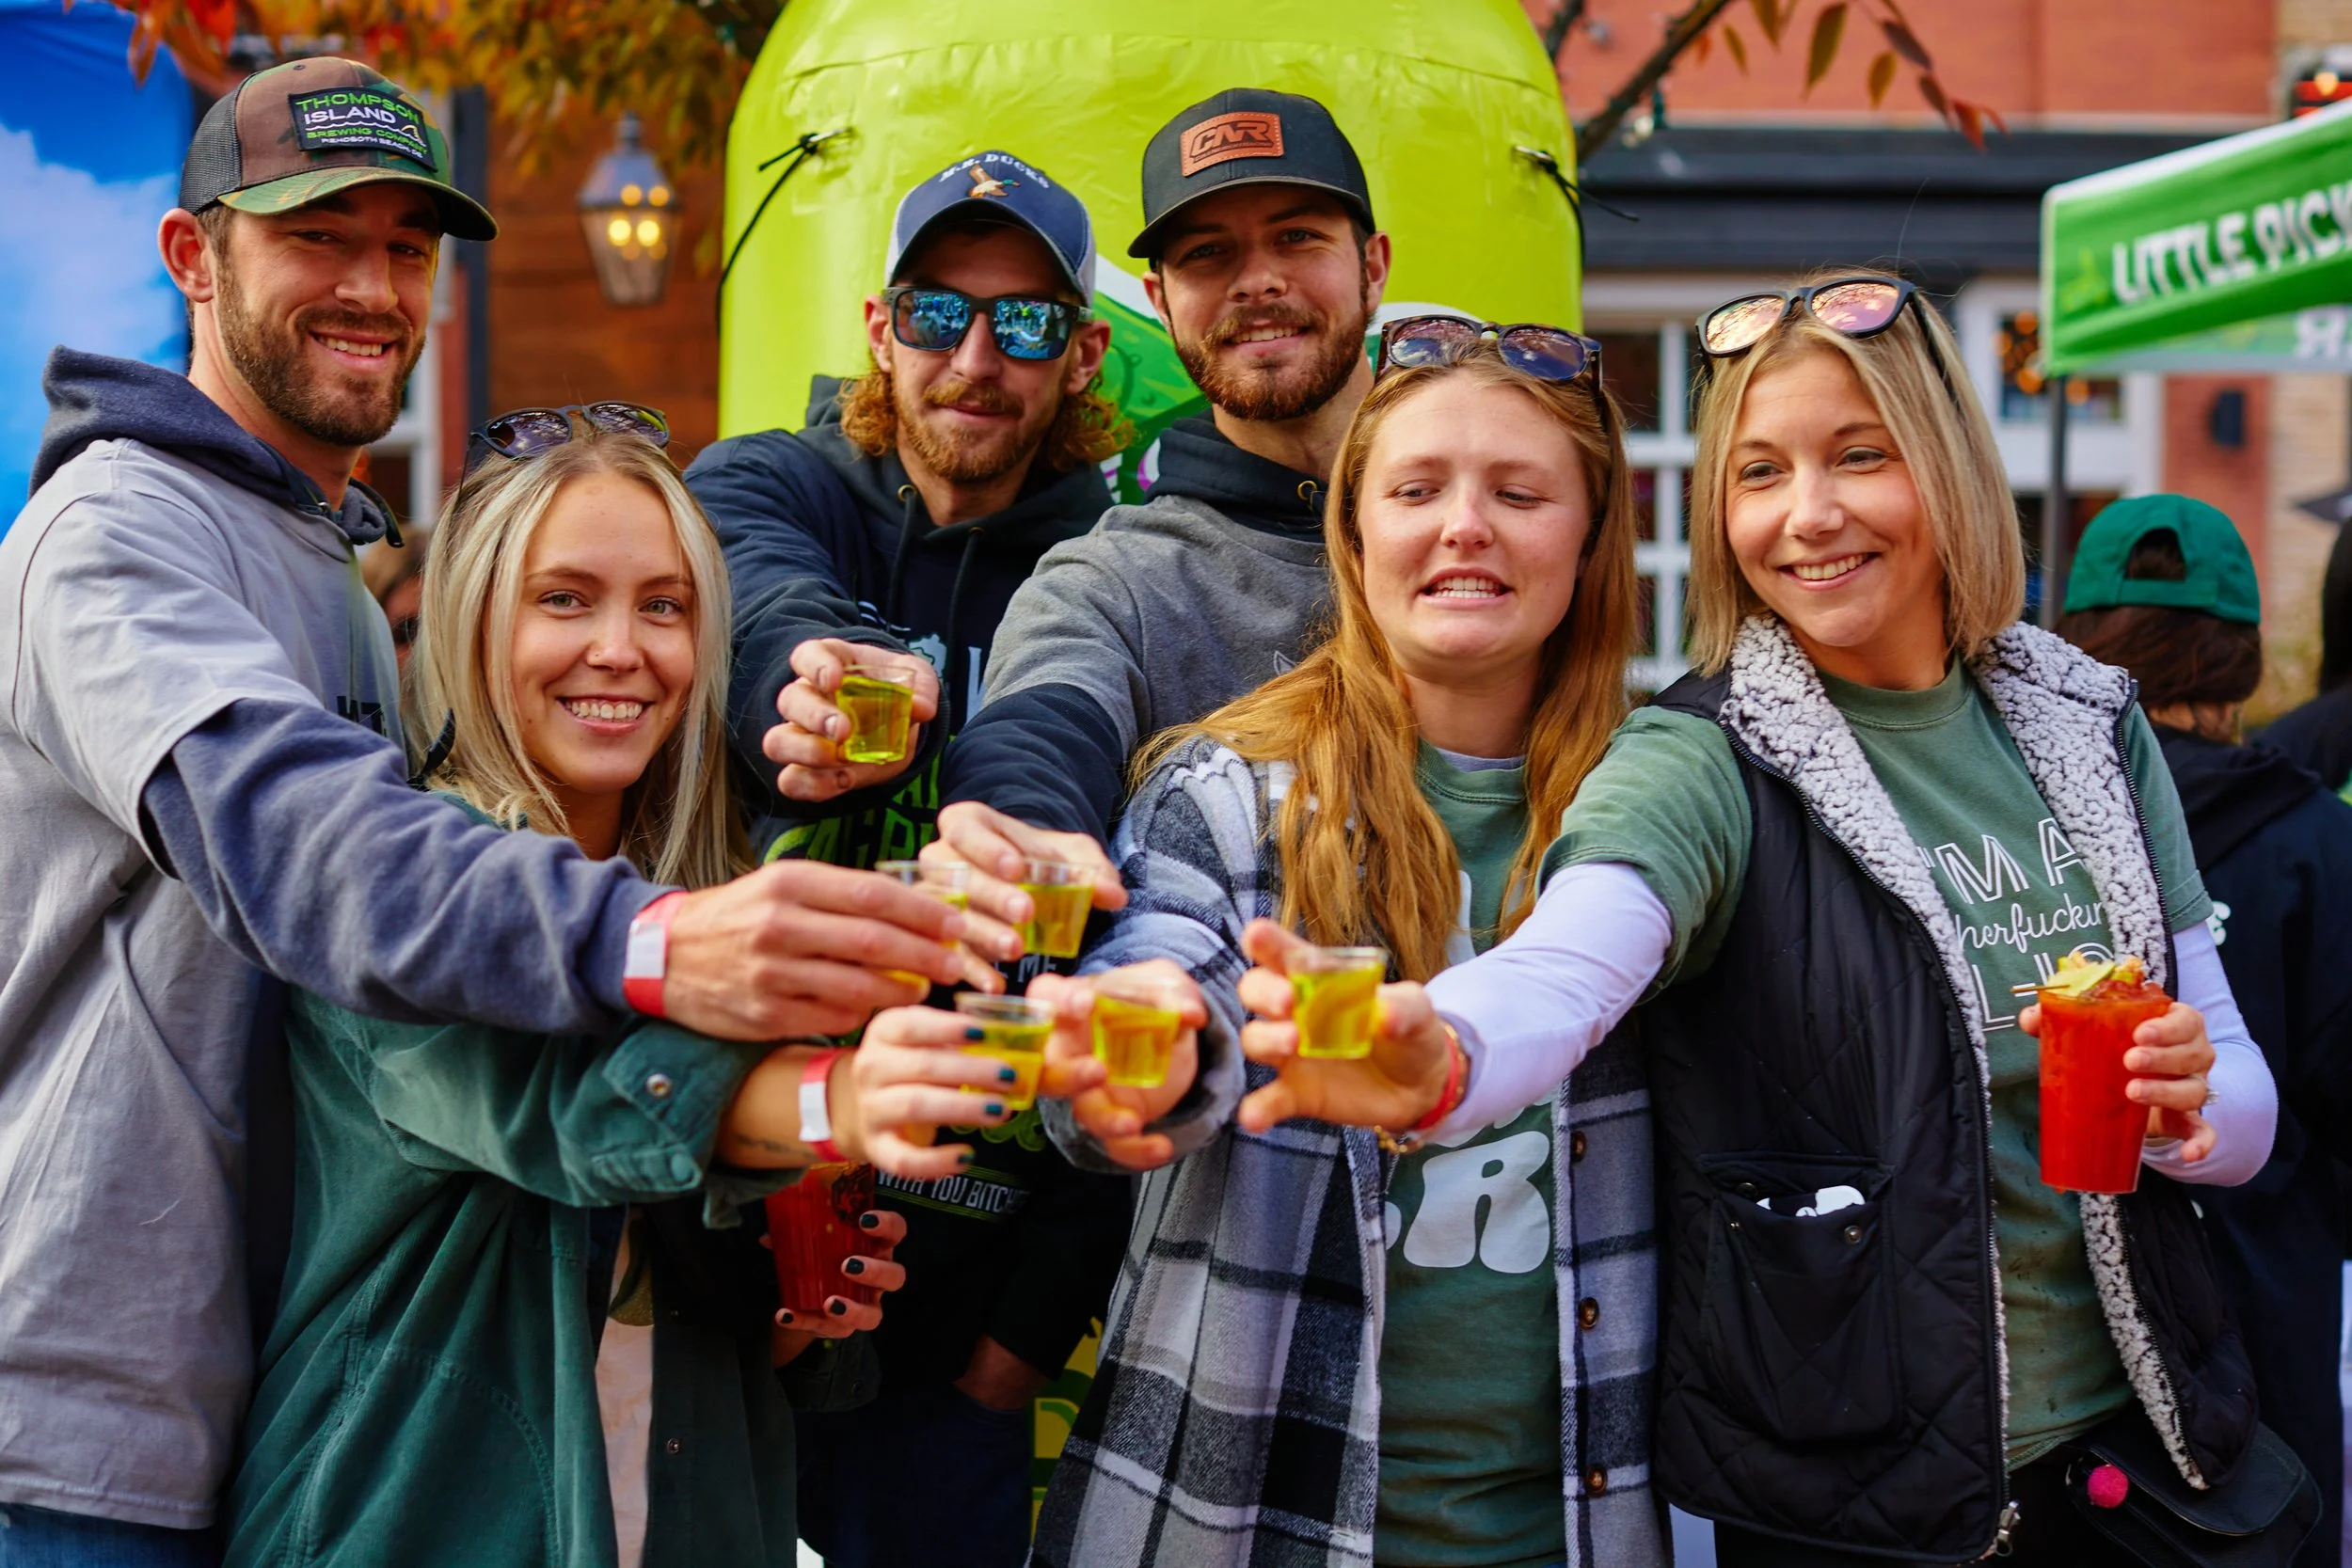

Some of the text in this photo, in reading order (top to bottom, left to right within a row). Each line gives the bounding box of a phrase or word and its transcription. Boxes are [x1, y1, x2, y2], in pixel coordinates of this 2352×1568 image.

[295, 92, 420, 124] THOMPSON
[304, 106, 396, 124] ISLAND
[307, 127, 428, 155] BREWING COMPANY
[984, 153, 1050, 188] DUCKS
[2112, 212, 2254, 304] LITTLE
[930, 1175, 969, 1204] YOU
[965, 1180, 1031, 1215] BITCH
